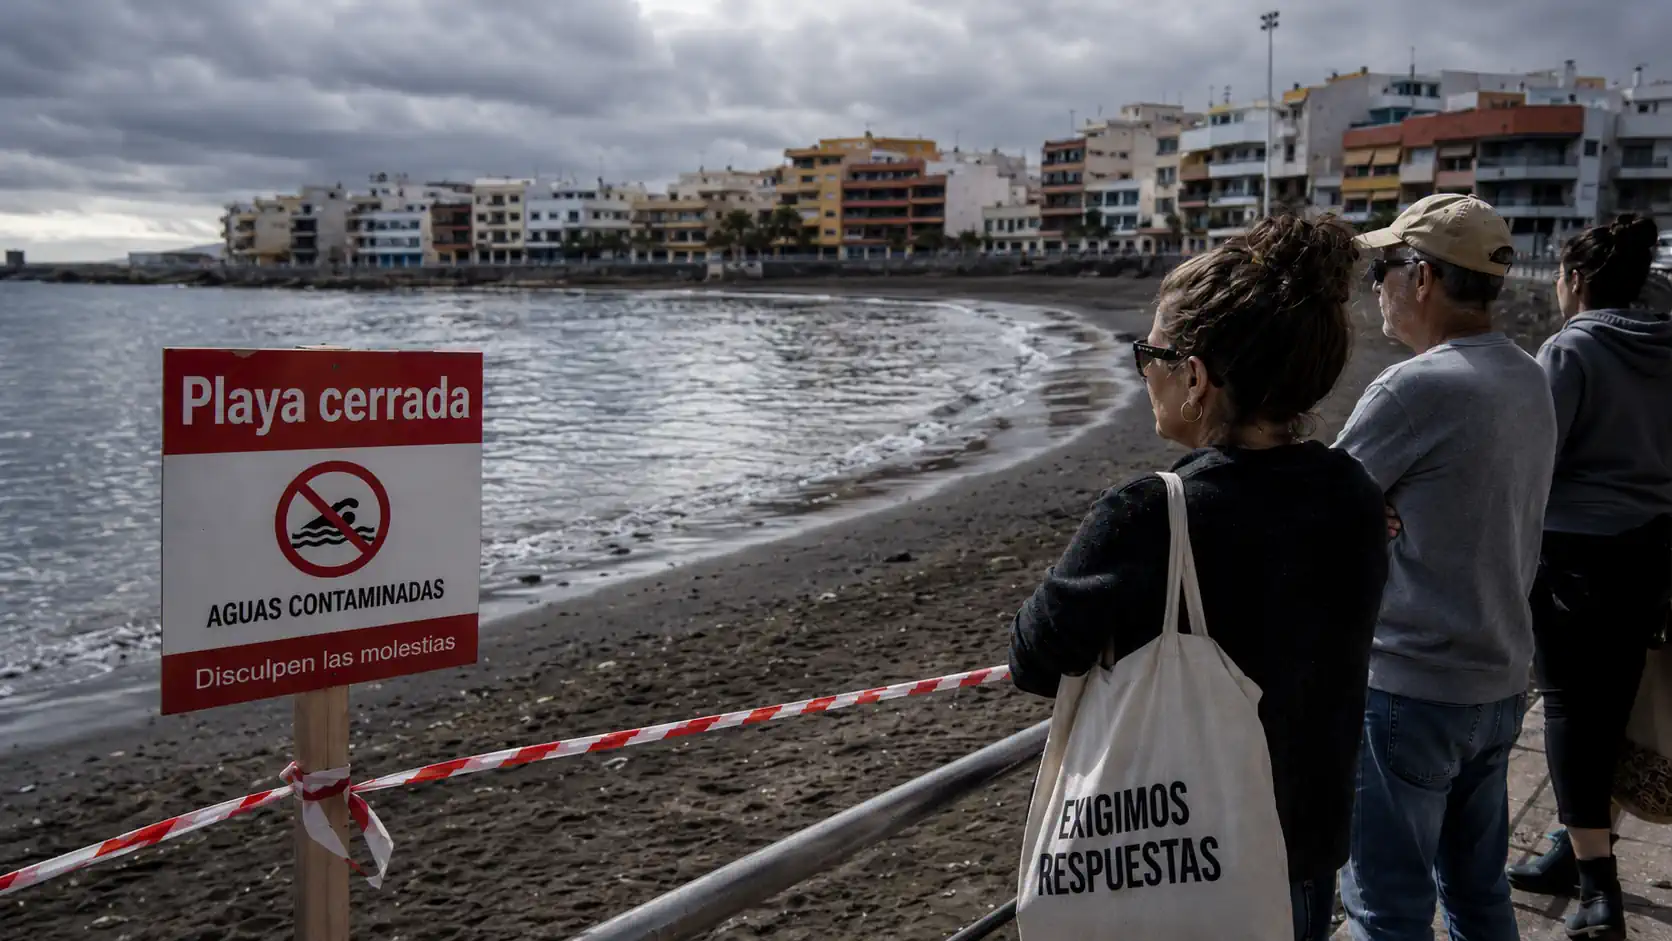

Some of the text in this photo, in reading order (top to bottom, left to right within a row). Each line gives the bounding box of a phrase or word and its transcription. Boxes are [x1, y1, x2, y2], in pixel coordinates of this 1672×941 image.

[182, 375, 470, 436] Playa cerrada
[207, 578, 445, 628] AGUAS CONTAMINADAS
[196, 634, 456, 689] Disculpen las molestias
[1058, 780, 1190, 840] EXIGIMOS
[1038, 835, 1222, 896] RESPUESTAS
